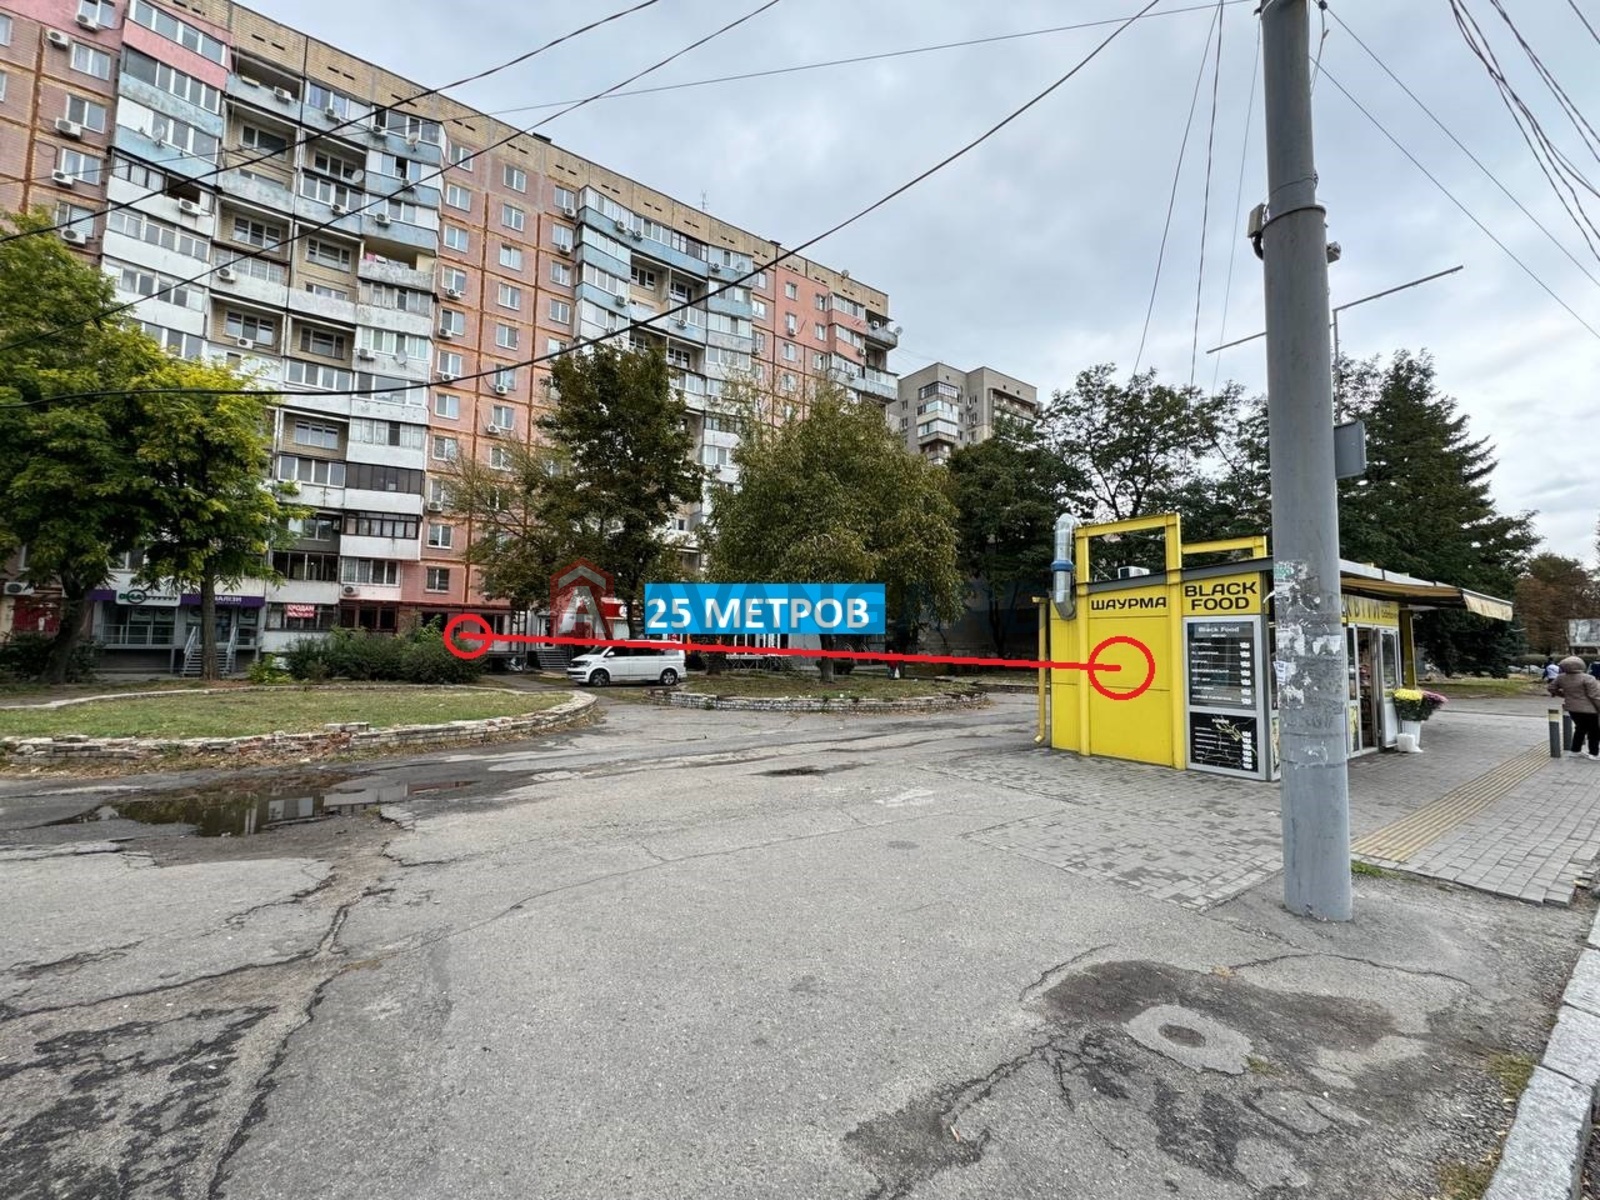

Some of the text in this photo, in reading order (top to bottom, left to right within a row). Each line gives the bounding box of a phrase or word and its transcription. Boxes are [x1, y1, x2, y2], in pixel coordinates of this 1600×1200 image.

[1184, 581, 1257, 598] BLACK
[1091, 596, 1167, 611] ШАУРМА
[1191, 596, 1250, 611] FOOD
